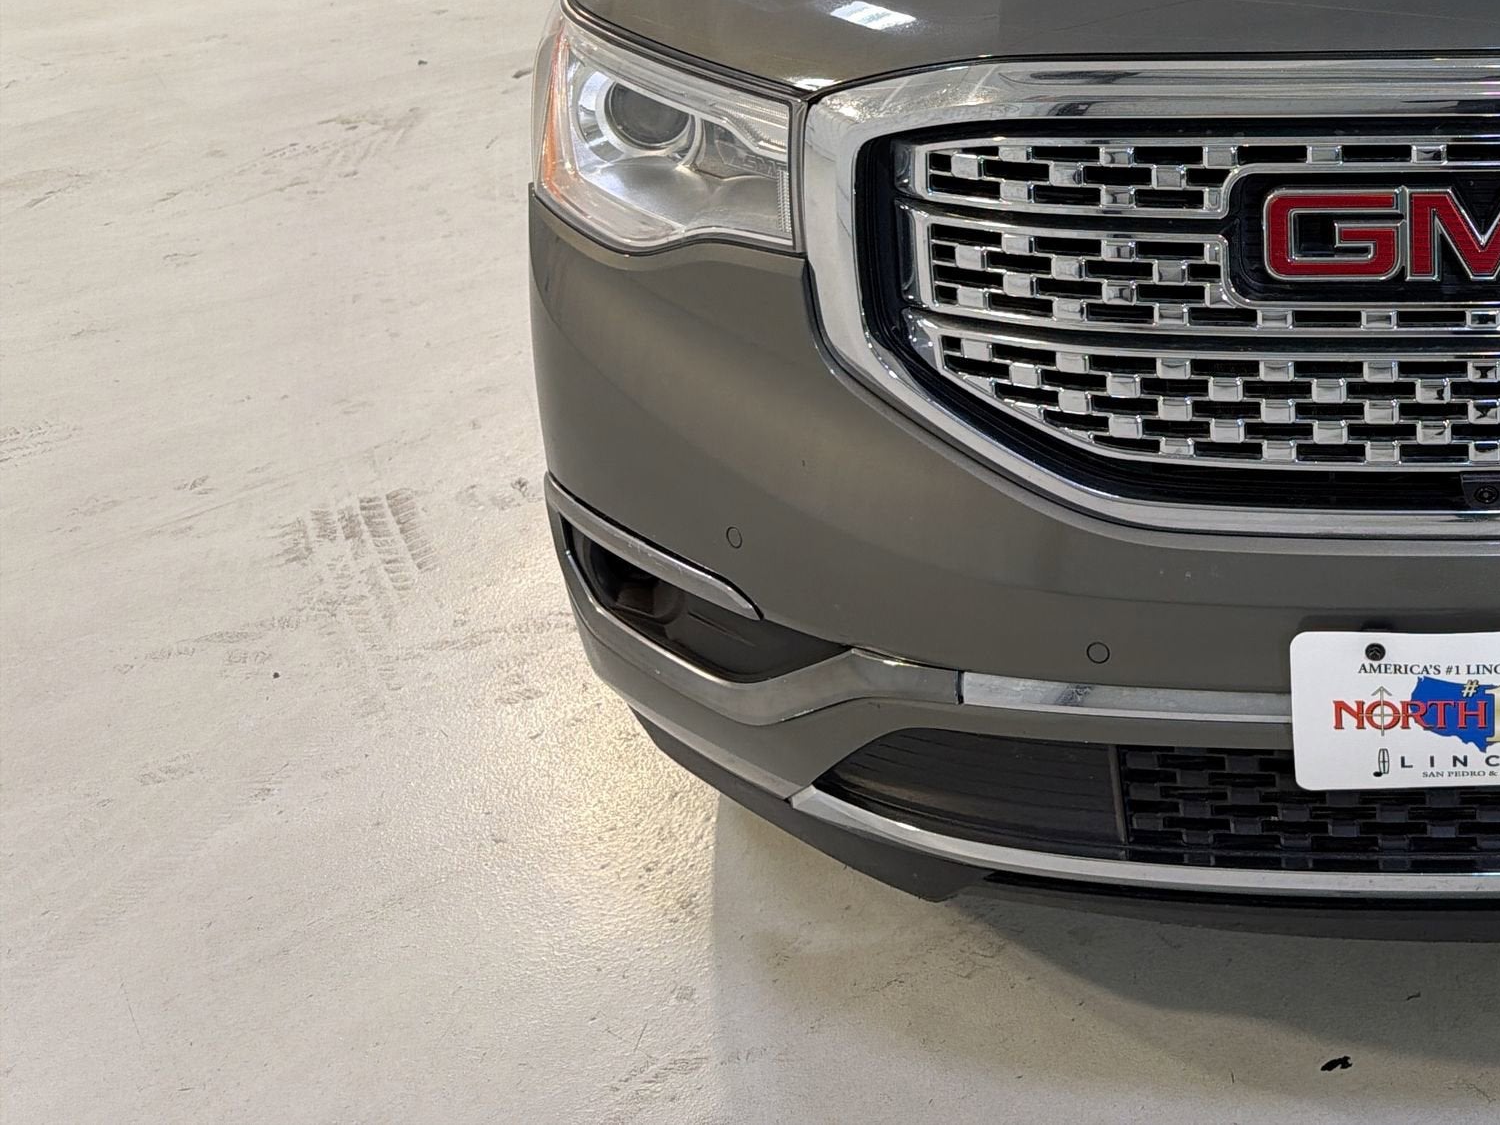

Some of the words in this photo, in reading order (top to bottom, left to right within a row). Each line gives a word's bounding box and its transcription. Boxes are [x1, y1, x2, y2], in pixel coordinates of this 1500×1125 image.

[1358, 664, 1441, 675] AMERICA'S
[1445, 665, 1460, 675] #1
[1333, 700, 1488, 730] NORTH
